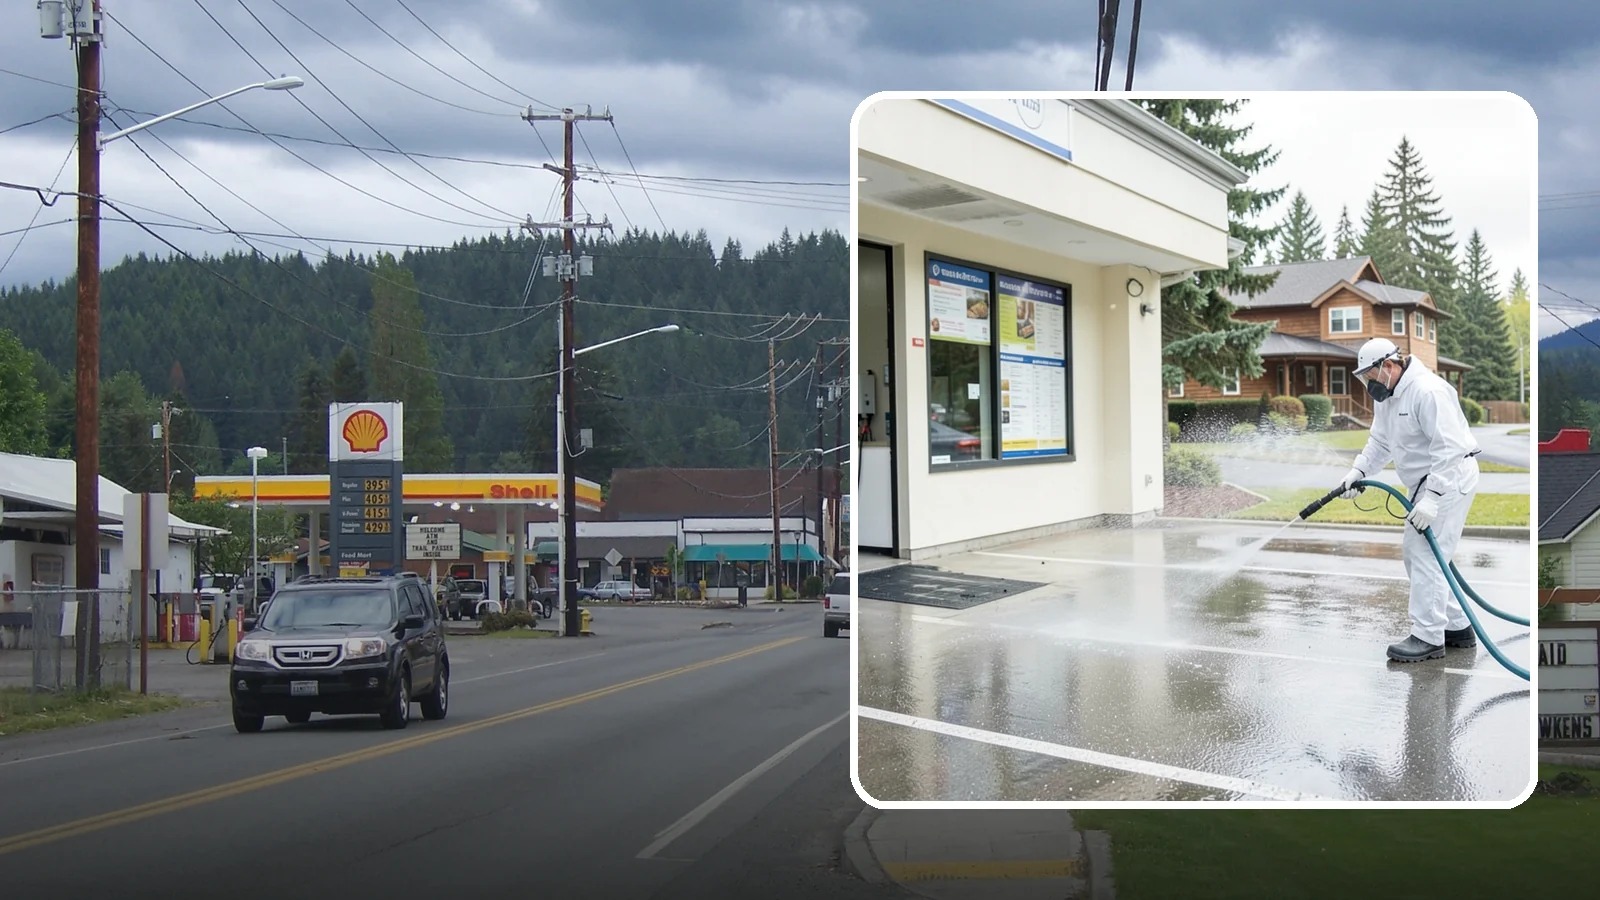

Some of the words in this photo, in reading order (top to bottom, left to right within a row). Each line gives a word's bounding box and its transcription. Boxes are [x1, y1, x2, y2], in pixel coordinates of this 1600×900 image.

[366, 480, 384, 490] 395
[490, 484, 547, 499] Shell
[365, 494, 384, 504] 405
[365, 508, 384, 518] 415
[365, 523, 384, 533] 429
